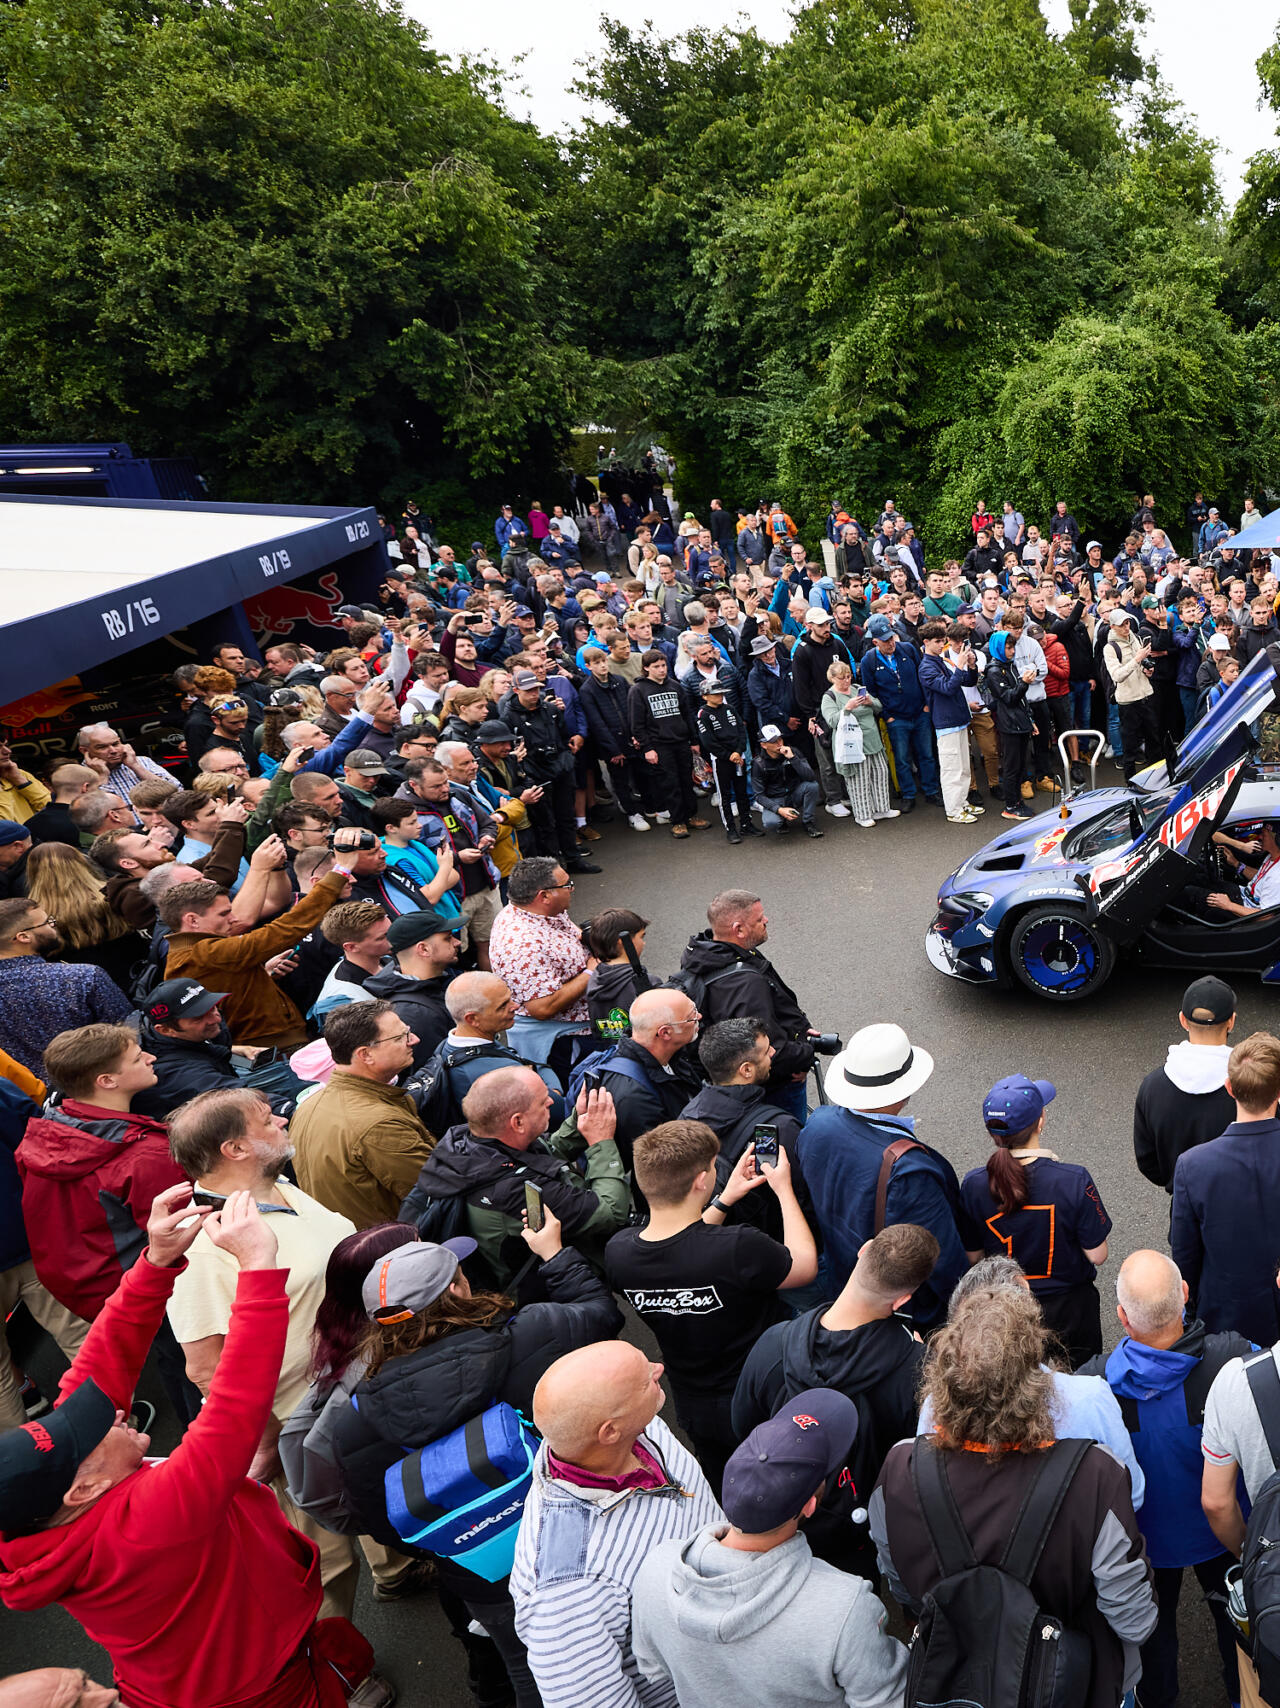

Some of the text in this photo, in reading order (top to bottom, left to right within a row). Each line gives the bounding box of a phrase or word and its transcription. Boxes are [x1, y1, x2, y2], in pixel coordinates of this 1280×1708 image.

[344, 520, 370, 543] RB/20
[258, 549, 292, 577] RB/19
[101, 597, 161, 641] RB/16
[1027, 887, 1059, 897] TOYO
